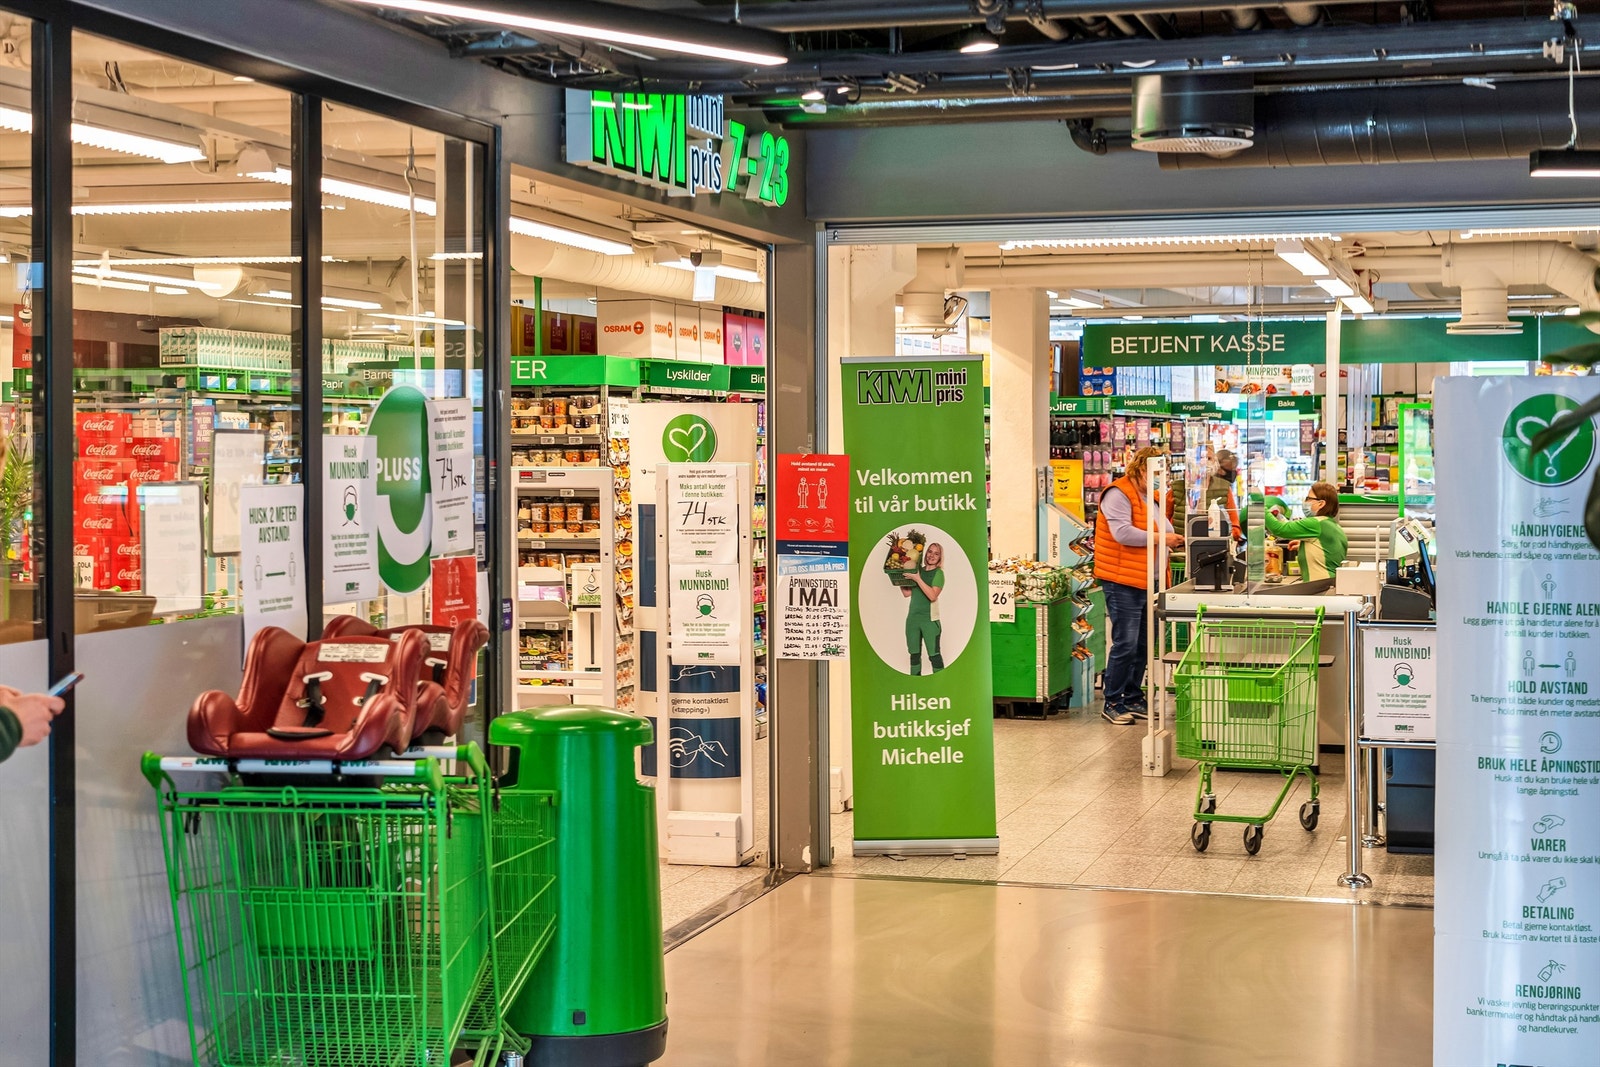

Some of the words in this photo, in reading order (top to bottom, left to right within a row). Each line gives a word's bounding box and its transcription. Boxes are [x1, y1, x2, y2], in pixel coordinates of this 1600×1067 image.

[690, 139, 722, 197] pris
[679, 328, 692, 337] OSRAM
[704, 330, 716, 339] OSRAM
[1111, 335, 1205, 354] BETJENT
[1211, 334, 1285, 352] KASSE
[666, 367, 711, 382] Lyskilder
[857, 368, 933, 405] KIWI
[934, 367, 967, 386] mini
[935, 385, 964, 406] pris
[1124, 398, 1157, 406] Hermetikk
[329, 460, 369, 479] MUNNBIND!
[376, 457, 422, 482] PLUSS
[435, 458, 454, 491] 74
[856, 467, 972, 486] Velkommen
[854, 495, 873, 513] til
[879, 495, 909, 512] vår
[914, 493, 977, 512] butikk
[249, 506, 268, 524] HUSK
[269, 507, 274, 523] 2
[276, 506, 297, 523] METER
[677, 501, 707, 525] 74
[1511, 521, 1585, 537] HÅNDHYGIENE
[1520, 540, 1531, 548] for
[1455, 550, 1471, 558] Vask
[1472, 551, 1503, 559] hendene
[1523, 551, 1542, 560] såpe
[1542, 553, 1553, 561] og
[695, 569, 712, 578] Husk
[679, 578, 729, 591] MUNNBIND!
[789, 576, 838, 588] ÅPNINGSTIDER
[799, 588, 838, 607] MAI
[992, 592, 1007, 605] 26
[1487, 602, 1530, 615] HANDLE
[1533, 602, 1572, 616] GJERNE
[1463, 617, 1480, 626] Legg
[1481, 618, 1504, 626] gjerne
[1526, 618, 1563, 627] handletur
[1564, 619, 1583, 627] alene
[1584, 619, 1594, 627] for
[1393, 636, 1412, 646] Husk
[1528, 630, 1554, 638] kunder
[1375, 647, 1431, 660] MUNNBIND!
[1508, 680, 1537, 694] HOLD
[1540, 681, 1588, 695] AVSTAND
[671, 697, 691, 706] gjerne
[891, 693, 951, 711] Hilsen
[1471, 694, 1480, 702] Ta
[1517, 696, 1537, 705] både
[1538, 696, 1564, 705] kunder
[1565, 698, 1575, 707] og
[1516, 708, 1538, 716] minst
[1539, 707, 1549, 716] én
[1550, 708, 1573, 717] meter
[873, 718, 971, 741] butikksjef
[881, 746, 964, 766] Michelle
[1478, 756, 1506, 770] BRUK
[1510, 758, 1537, 772] HELE
[1494, 774, 1513, 782] Husk
[1524, 775, 1534, 783] du
[1536, 775, 1550, 784] kan
[1551, 776, 1572, 784] bruke
[1573, 776, 1588, 785] hele
[1589, 776, 1600, 785] vår
[1517, 786, 1537, 796] lange
[1530, 838, 1566, 852] VARER
[1478, 851, 1503, 861] Unngå
[1520, 853, 1531, 863] på
[1532, 855, 1551, 863] varer
[1552, 855, 1562, 863] du
[1579, 856, 1594, 864] skal
[1522, 905, 1574, 920] BETALING
[1524, 923, 1547, 932] gjerne
[1549, 923, 1593, 932] kontaktløst.
[1482, 930, 1500, 939] Bruk
[1539, 934, 1562, 943] kortet
[1572, 934, 1578, 943] å
[1579, 935, 1598, 943] taste
[1515, 984, 1581, 999] RENGJØRING
[1477, 997, 1485, 1005] Vi
[1537, 1002, 1600, 1012] berøringspunkter
[1466, 1007, 1522, 1019] bankterminaler
[1524, 1014, 1534, 1022] og
[1535, 1014, 1567, 1022] håndtak
[1568, 1014, 1578, 1024] på
[1517, 1024, 1527, 1033] og
[1528, 1024, 1579, 1034] handlekurver.
